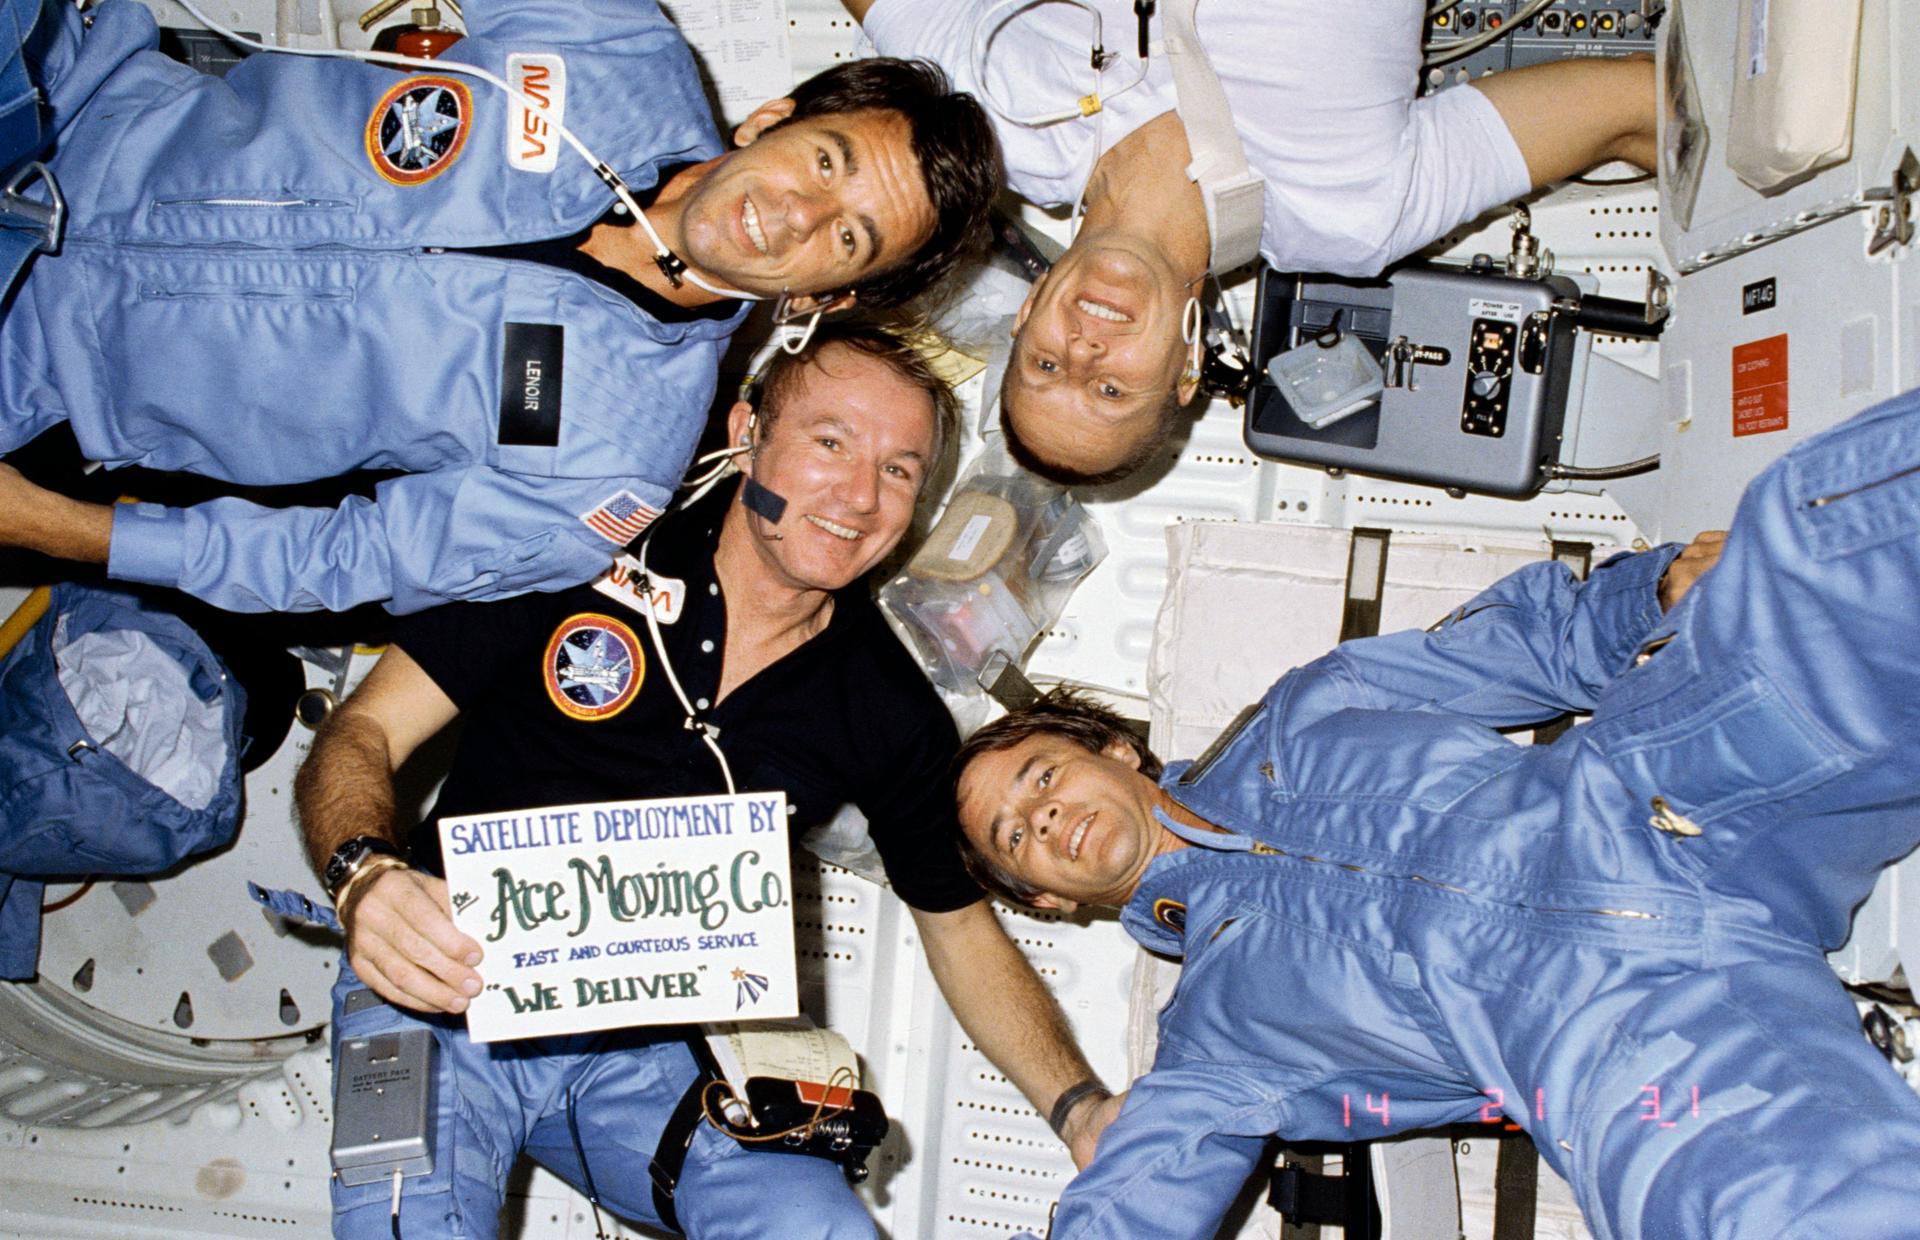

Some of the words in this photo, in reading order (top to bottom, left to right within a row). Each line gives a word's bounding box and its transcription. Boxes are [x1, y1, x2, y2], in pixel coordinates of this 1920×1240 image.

[522, 64, 550, 160] NASA
[524, 360, 541, 411] LENOIR
[451, 812, 582, 855] SATELLITE
[593, 802, 734, 842] DEPLOYMENT
[748, 800, 778, 833] BY
[486, 867, 571, 942] Ace
[567, 854, 729, 938] Moving
[730, 850, 789, 914] Co.
[512, 948, 560, 969] FAST
[568, 945, 601, 961] AND
[606, 936, 691, 956] COURTEOUS
[697, 931, 759, 950] SERVICE
